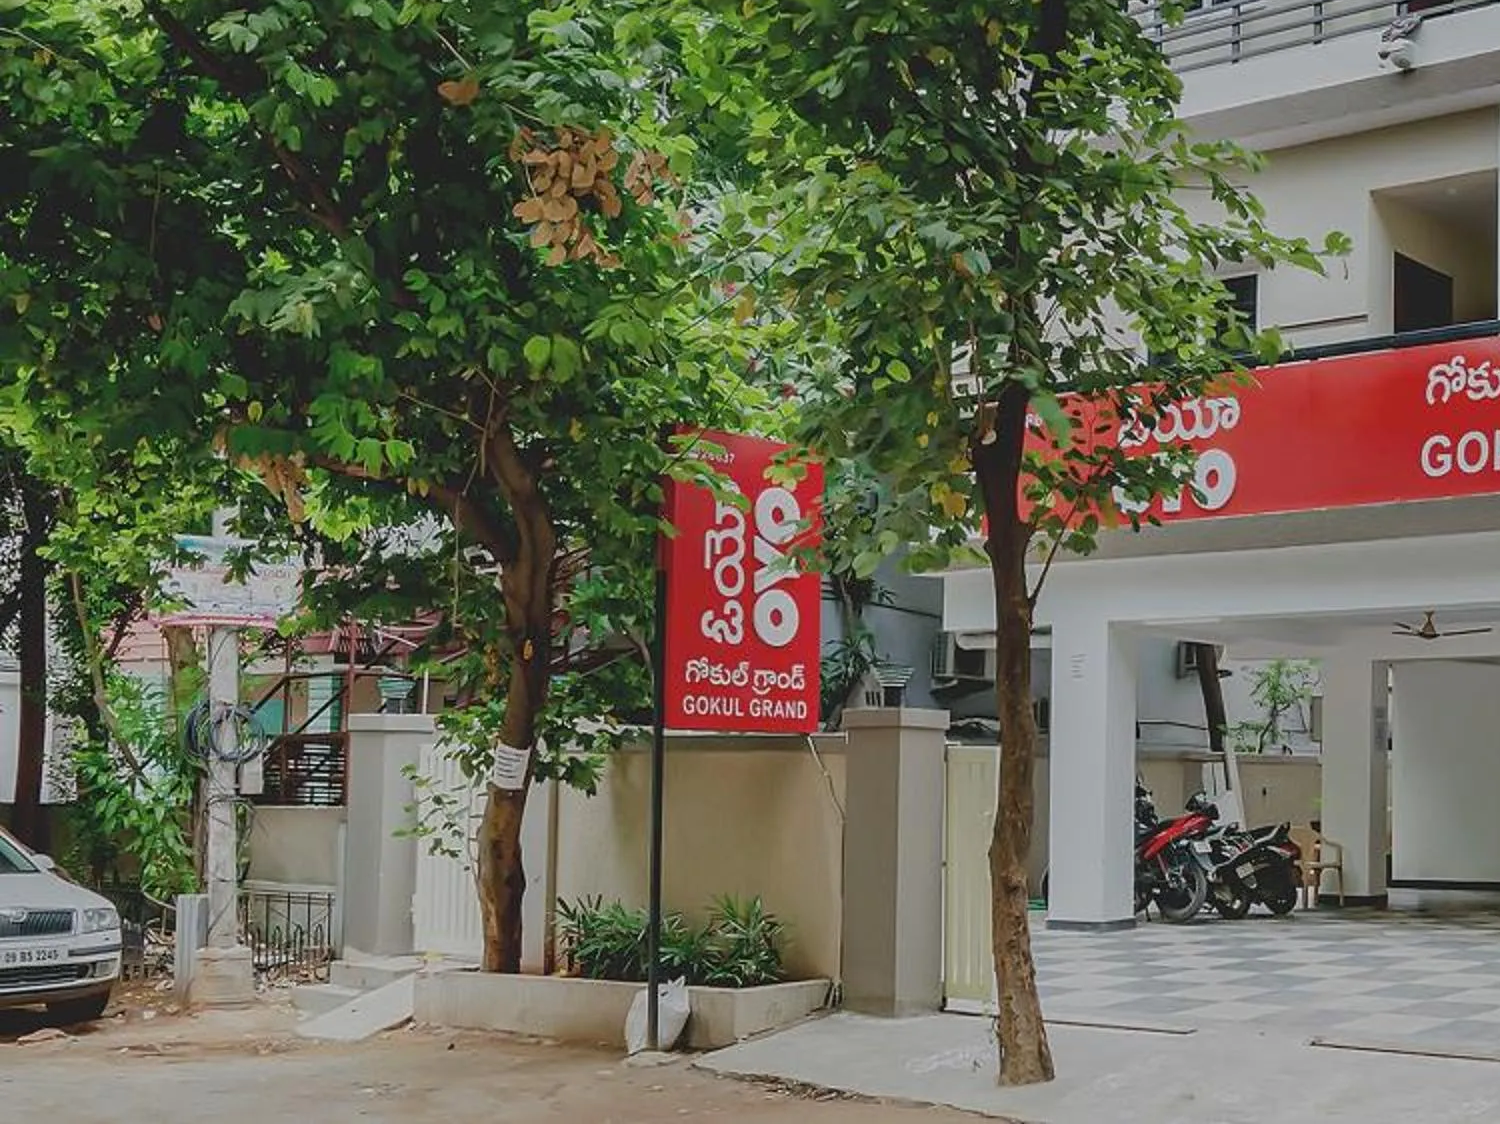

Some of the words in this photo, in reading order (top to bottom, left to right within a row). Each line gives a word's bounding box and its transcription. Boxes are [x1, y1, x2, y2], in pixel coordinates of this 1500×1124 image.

[753, 486, 801, 647] OYO
[685, 656, 750, 687] గోకుల్
[751, 663, 806, 695] గ్రాండ్
[683, 695, 744, 717] GOKUL
[749, 698, 808, 720] GRAND
